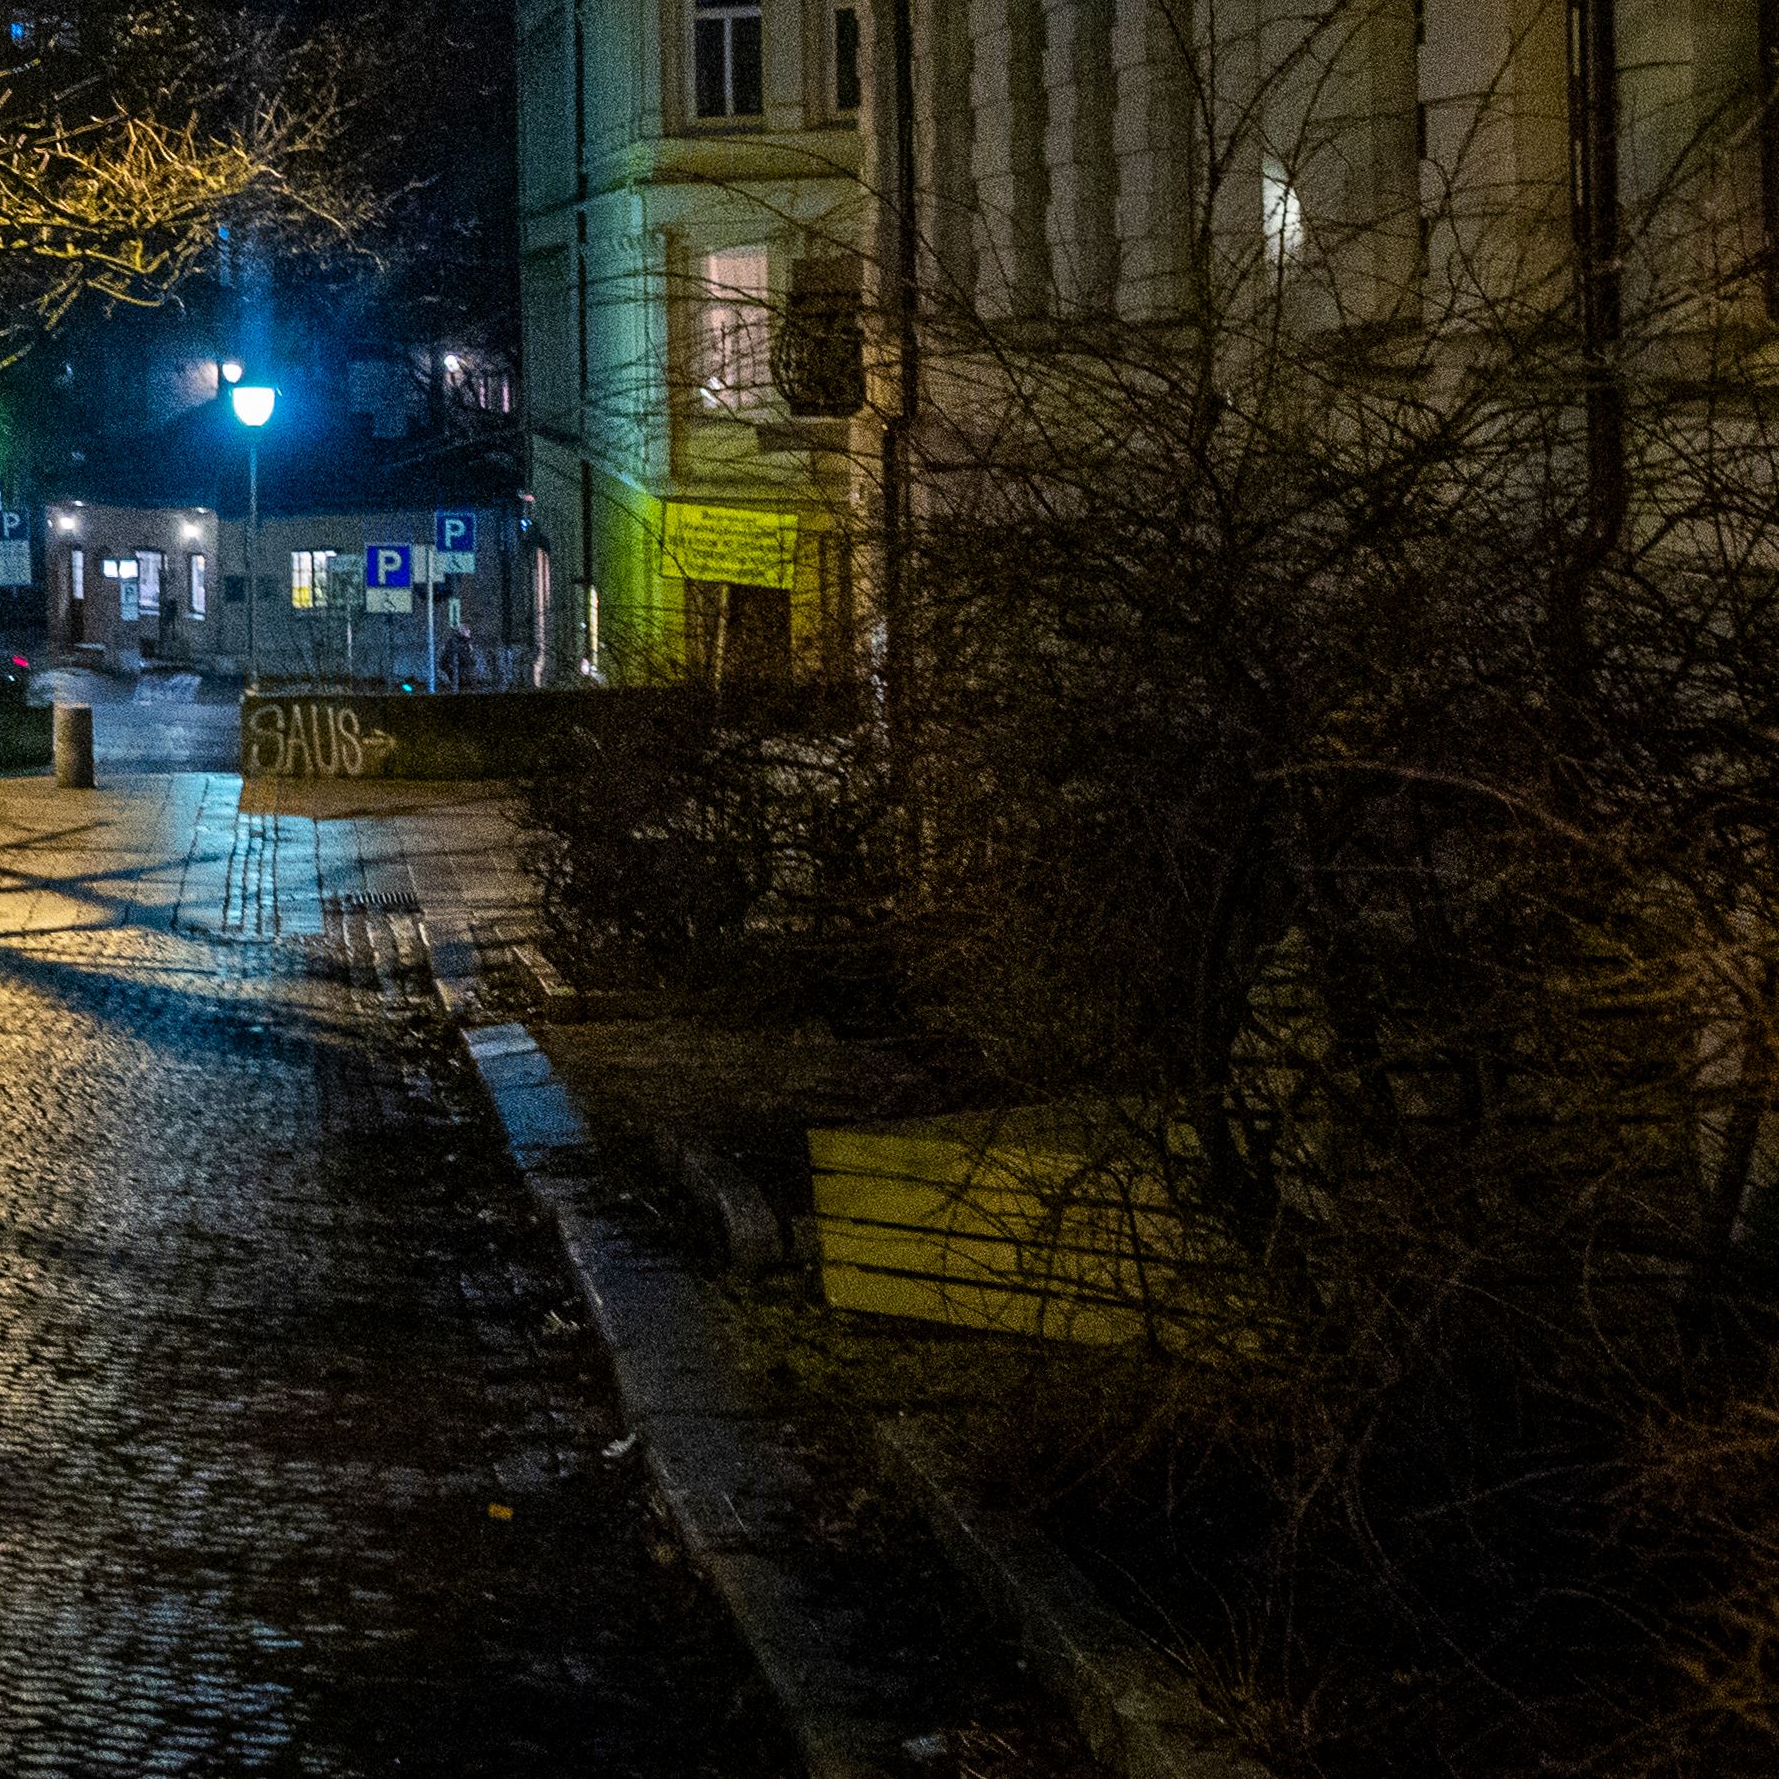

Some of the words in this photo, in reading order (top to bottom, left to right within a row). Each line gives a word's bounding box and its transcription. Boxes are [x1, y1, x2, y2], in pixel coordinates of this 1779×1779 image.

[3, 512, 20, 537] P
[445, 519, 466, 548] P
[378, 549, 402, 585] P
